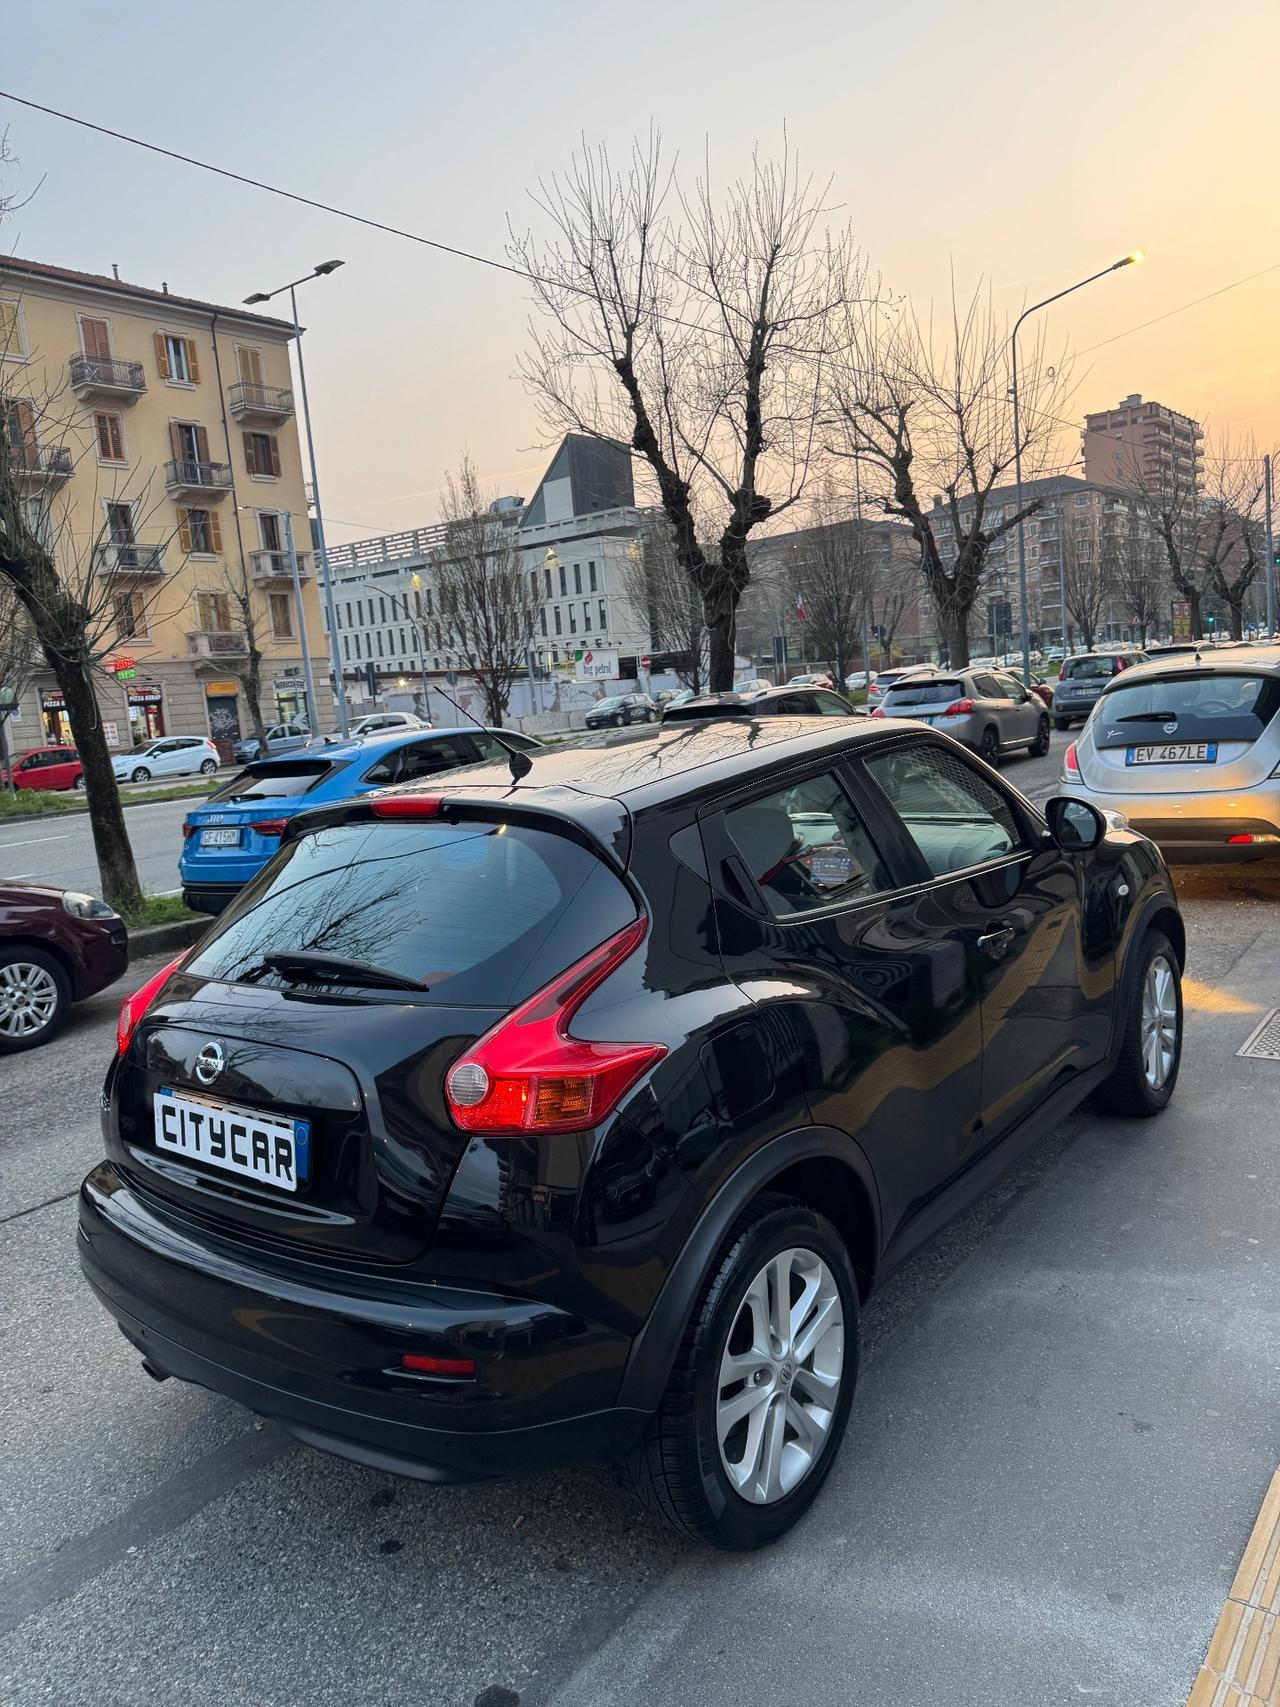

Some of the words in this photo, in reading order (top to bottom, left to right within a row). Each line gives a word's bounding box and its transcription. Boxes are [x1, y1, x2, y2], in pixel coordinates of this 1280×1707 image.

[1136, 747, 1154, 761] EV
[1160, 745, 1206, 760] 467LE
[162, 1104, 293, 1182] CITYCAR
